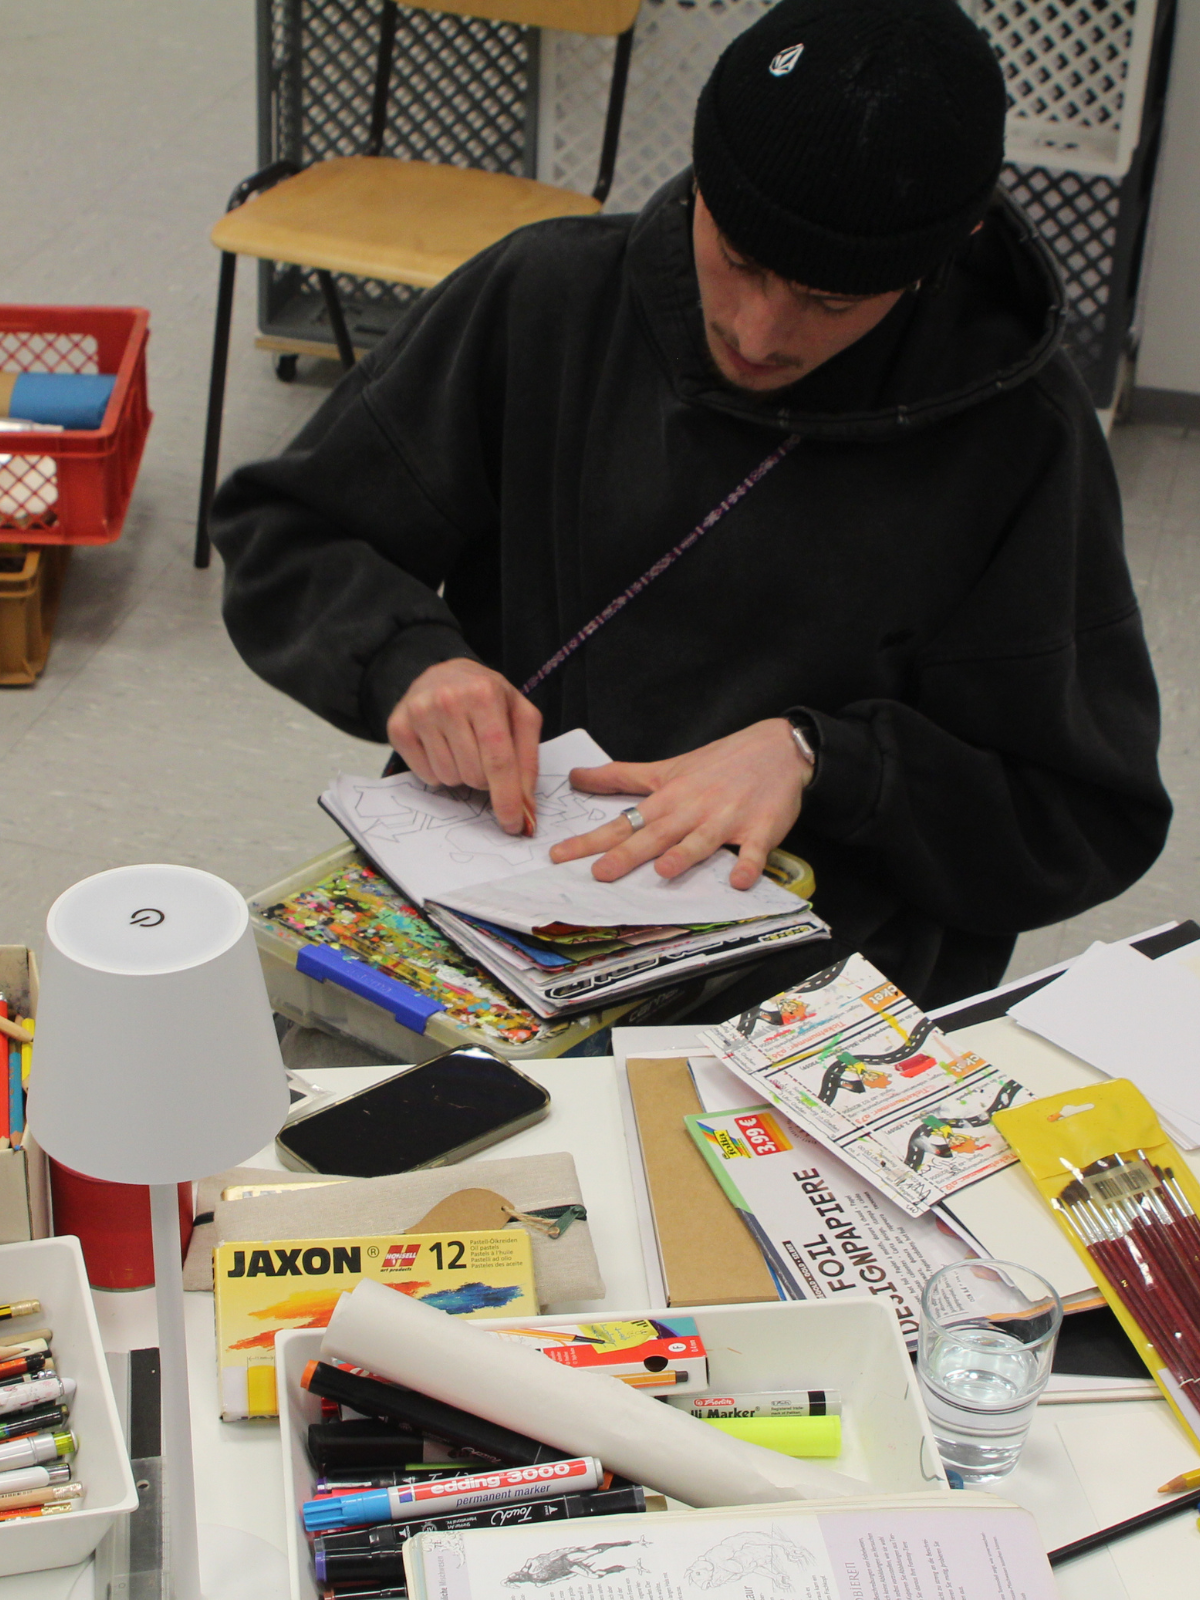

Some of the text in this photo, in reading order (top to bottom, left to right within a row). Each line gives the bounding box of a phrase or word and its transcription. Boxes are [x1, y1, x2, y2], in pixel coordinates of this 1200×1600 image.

[786, 1020, 846, 1051] Ticketnummer:
[869, 1086, 930, 1116] Ticketnummer:
[738, 1117, 757, 1127] €
[719, 1133, 737, 1156] folia
[746, 1127, 777, 1153] 3,99
[227, 1246, 362, 1278] JAXON
[429, 1240, 467, 1270] 12
[803, 1233, 857, 1293] FOIL
[707, 1407, 756, 1419] Marker
[430, 1474, 501, 1494] edding
[506, 1463, 571, 1483] 3000
[456, 1484, 551, 1508] permanent marker
[490, 1505, 532, 1526] Touch
